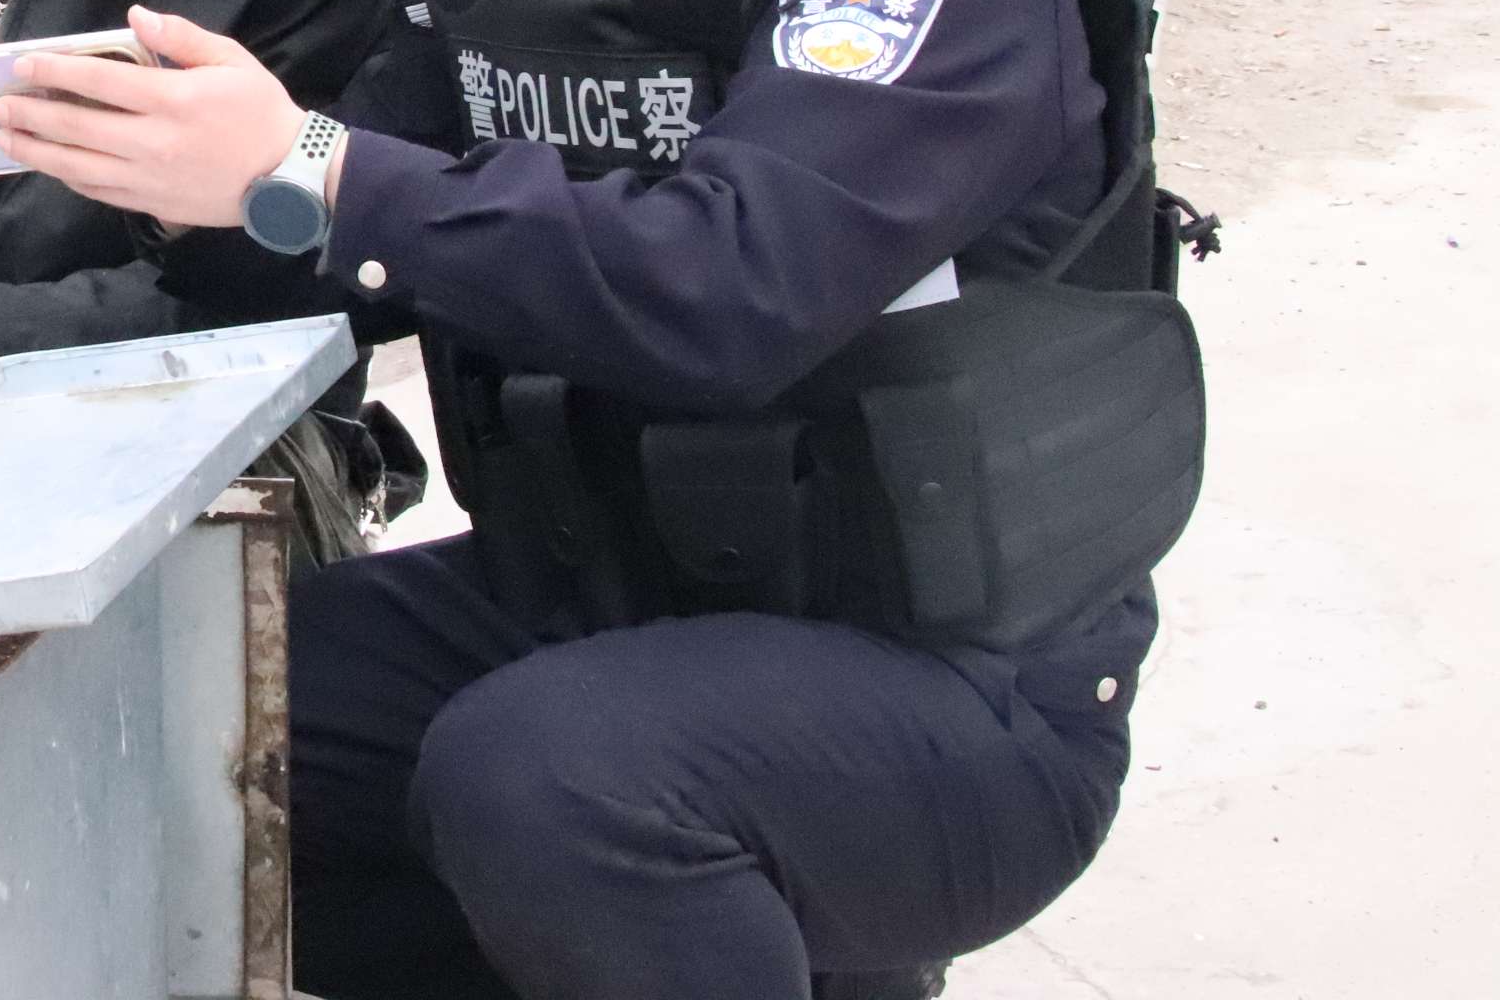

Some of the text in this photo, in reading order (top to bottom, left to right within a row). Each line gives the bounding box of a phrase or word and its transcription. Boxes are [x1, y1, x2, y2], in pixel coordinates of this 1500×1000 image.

[458, 49, 703, 162] 警 POLICE 察
